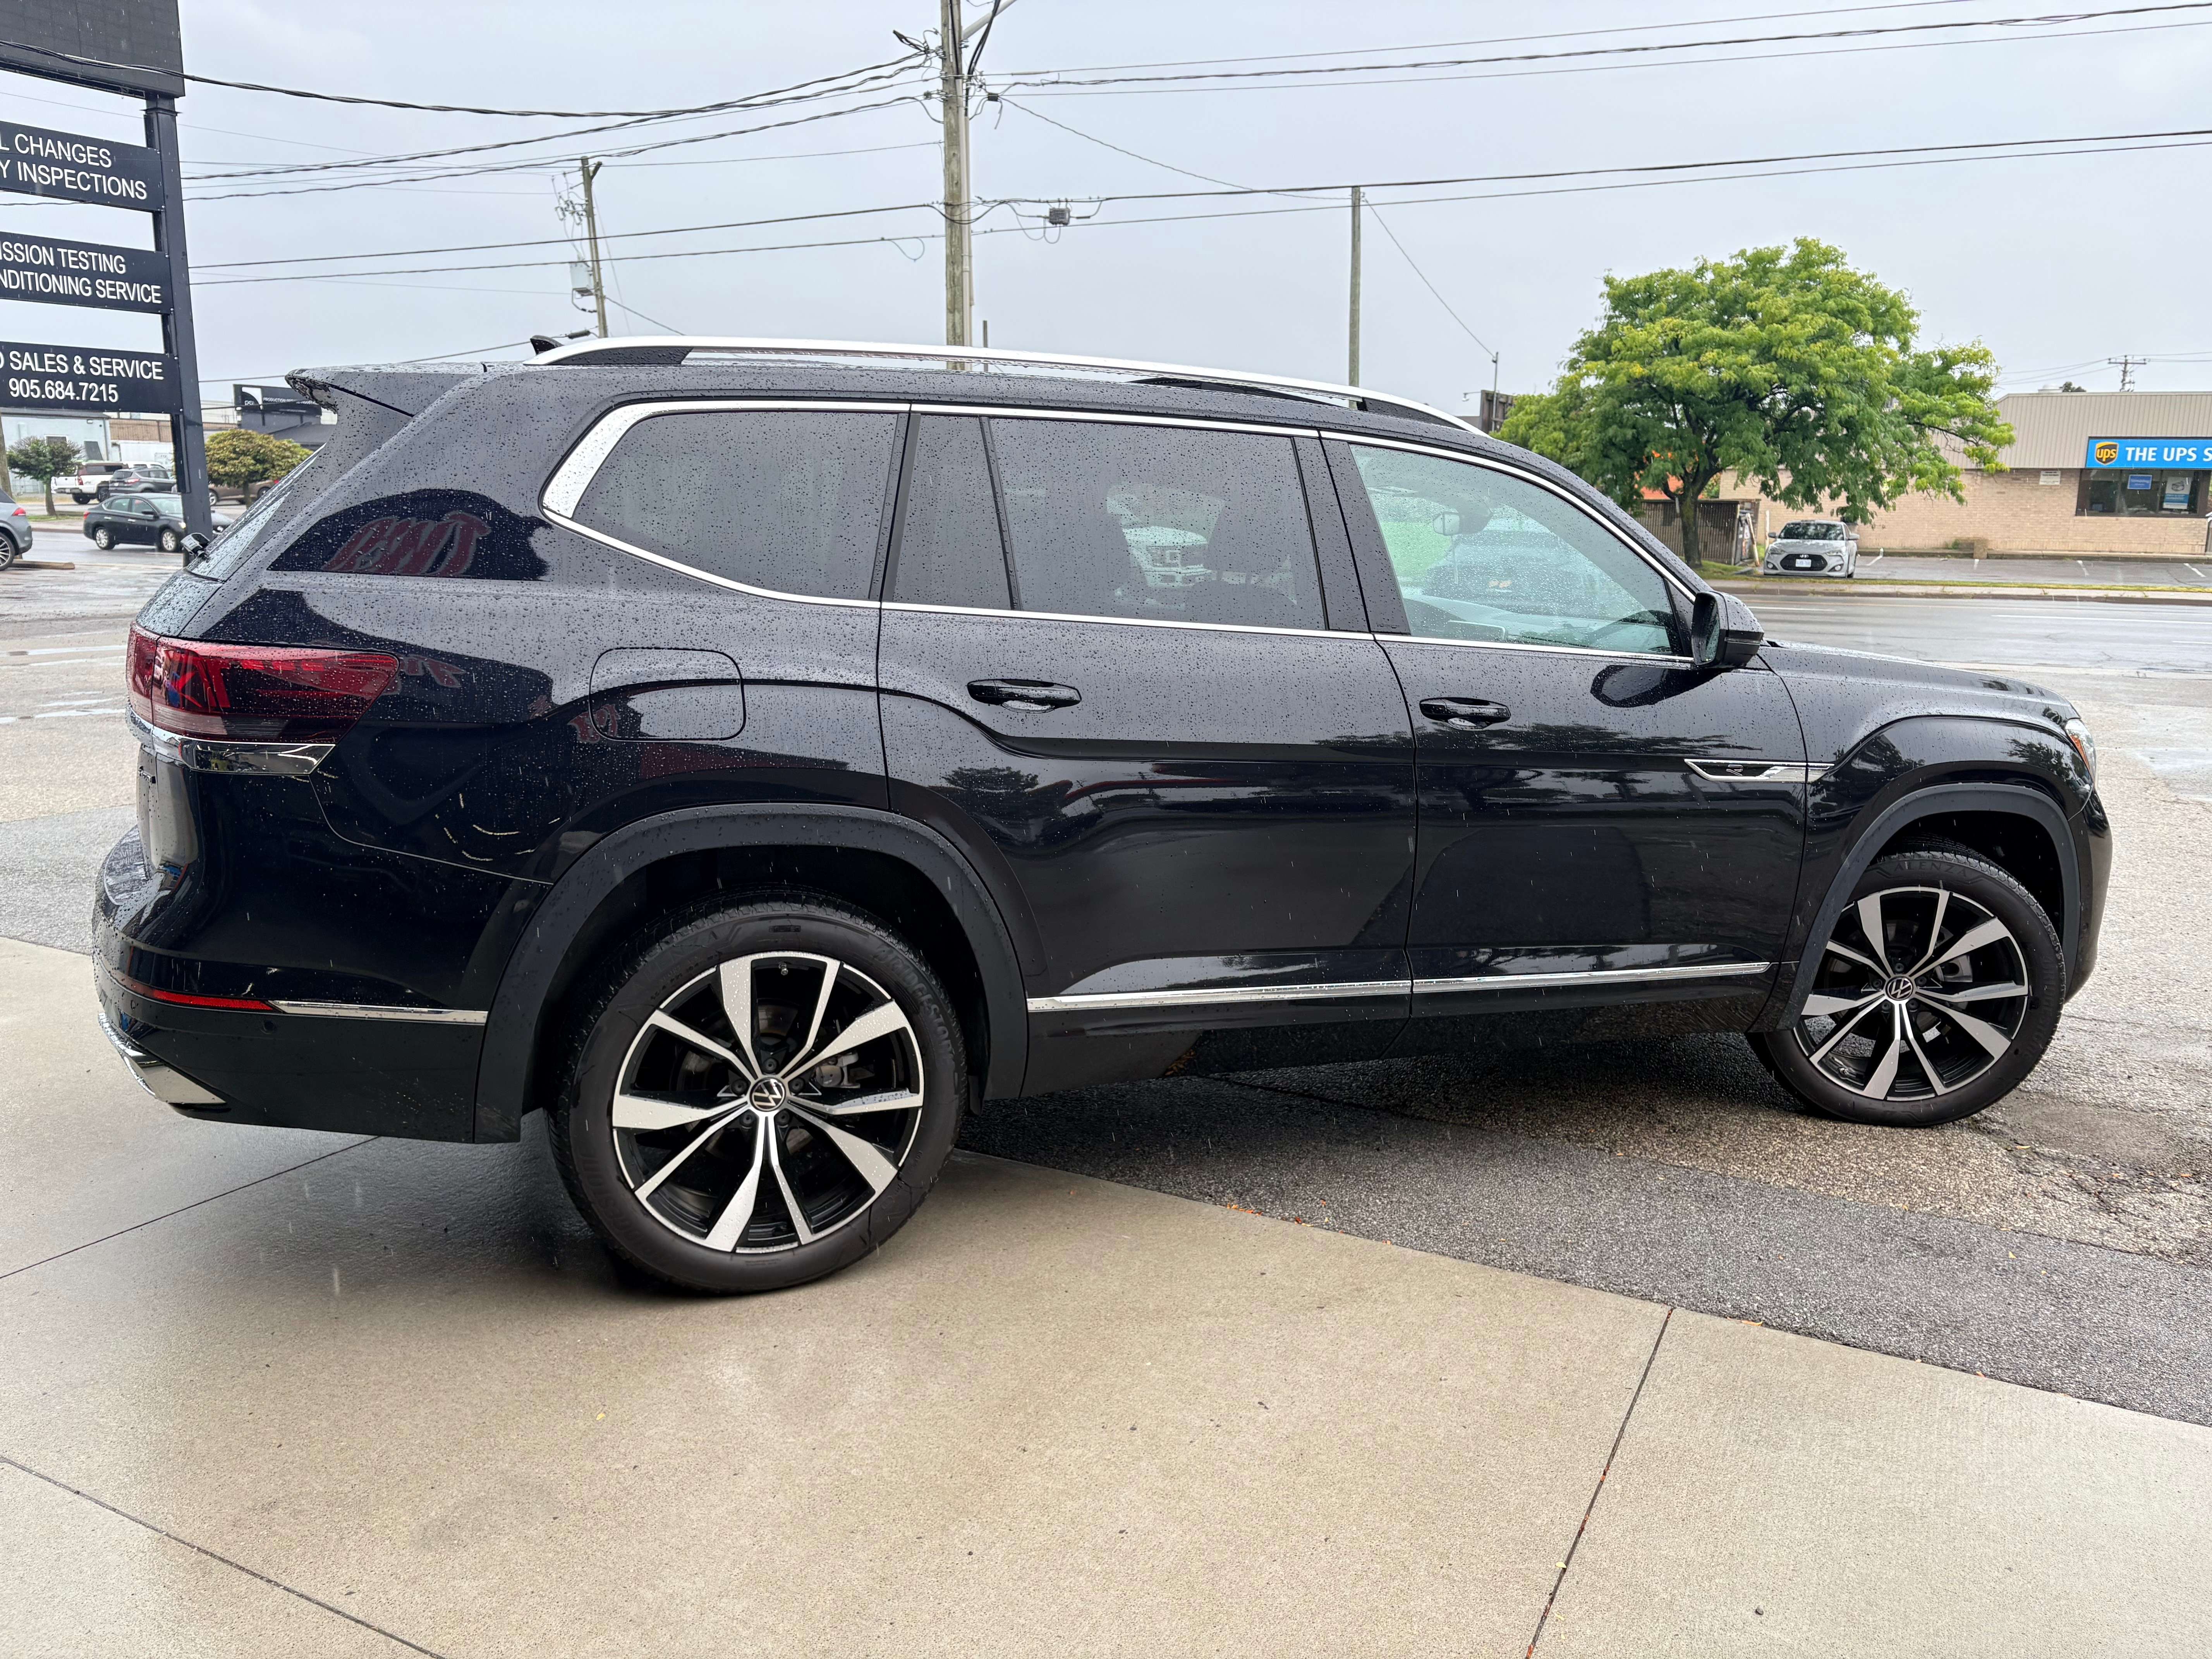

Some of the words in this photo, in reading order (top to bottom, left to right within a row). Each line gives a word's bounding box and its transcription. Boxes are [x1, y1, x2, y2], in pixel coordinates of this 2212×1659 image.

[15, 134, 112, 168] CHANGES
[17, 161, 147, 200] INSPECTIONS
[57, 248, 126, 274] TESTING
[95, 279, 163, 304] SERVICE
[9, 350, 69, 373] SALES
[73, 356, 86, 374] &
[89, 356, 165, 380] SERVICE
[9, 378, 118, 402] 905.684.7215
[2125, 447, 2157, 461] THE
[2163, 447, 2197, 461] UPS
